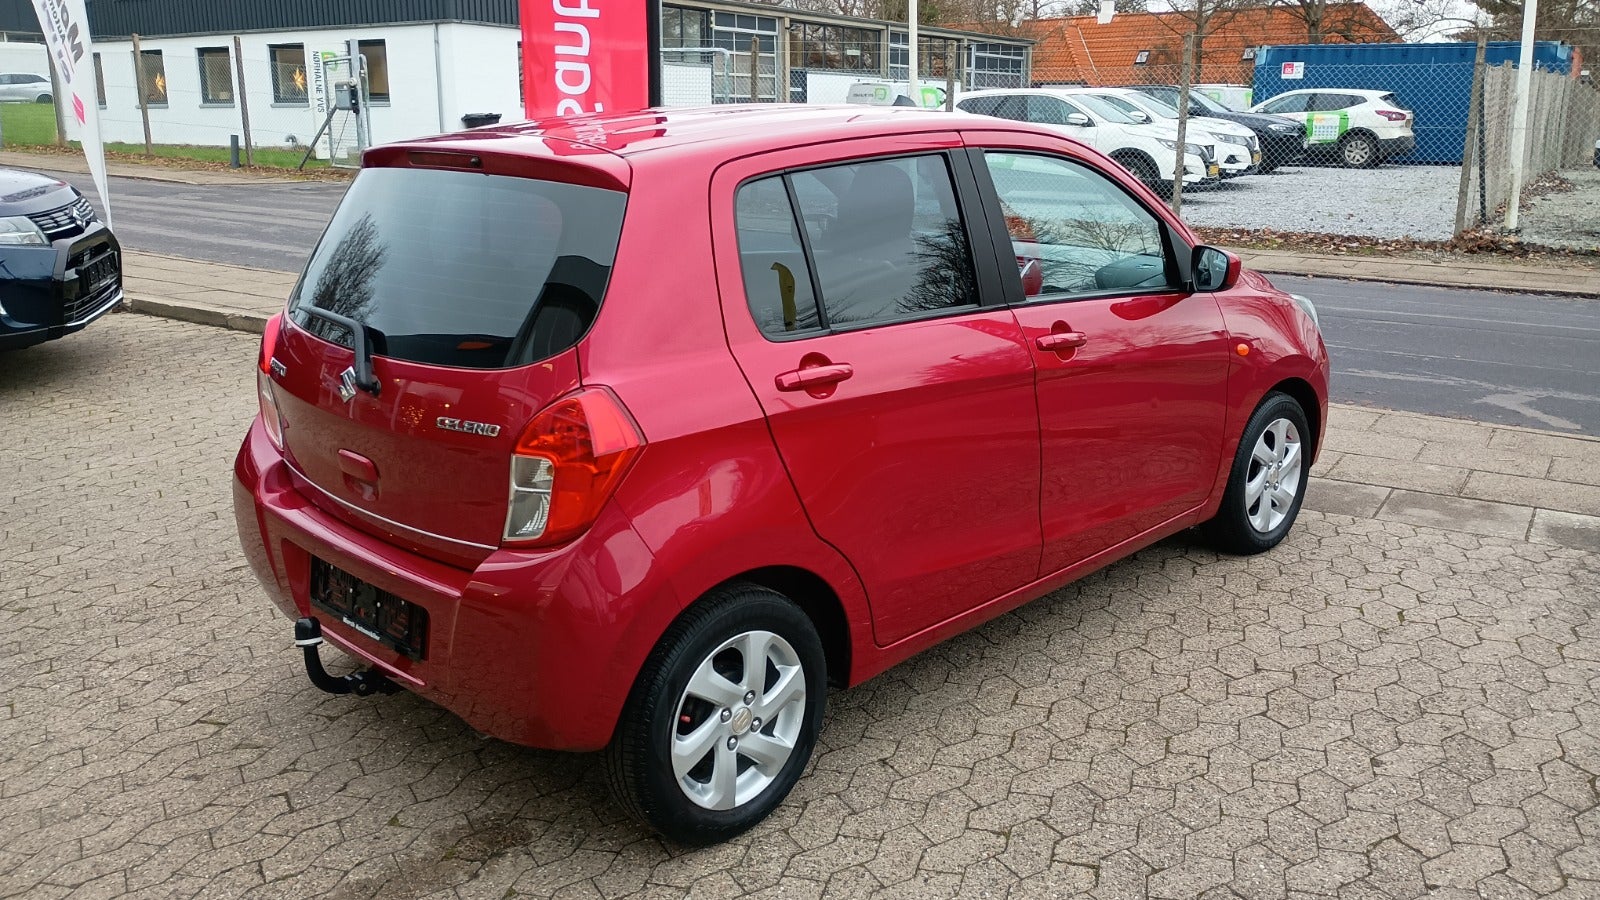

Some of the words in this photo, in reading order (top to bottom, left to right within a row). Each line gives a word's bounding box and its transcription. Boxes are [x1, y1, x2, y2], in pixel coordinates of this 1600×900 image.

[312, 50, 323, 94] NØRHALNE
[316, 97, 325, 113] VVS
[436, 416, 501, 437] CELERIO
